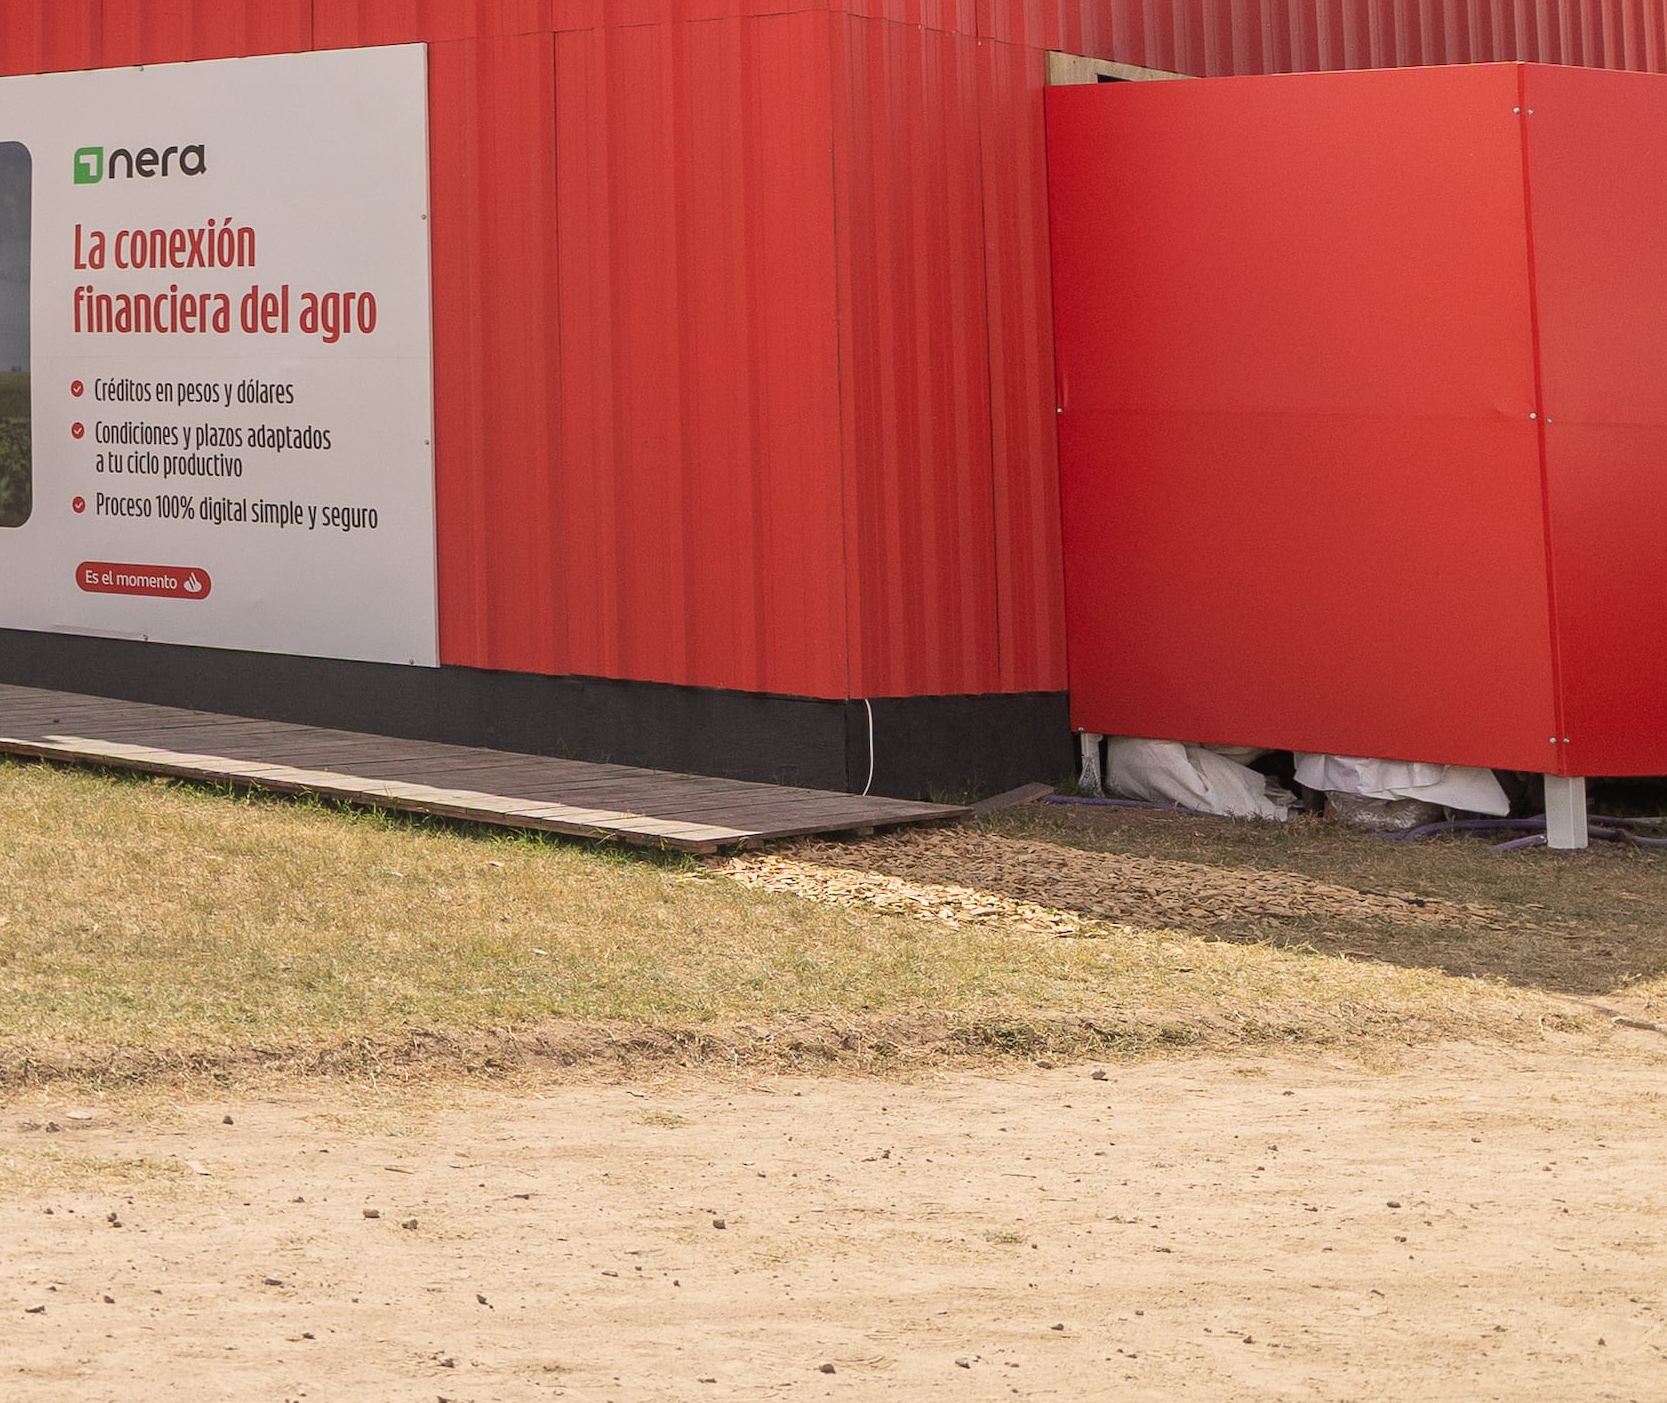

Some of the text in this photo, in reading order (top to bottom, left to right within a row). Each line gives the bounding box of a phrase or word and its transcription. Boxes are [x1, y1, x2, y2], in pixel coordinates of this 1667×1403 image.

[108, 143, 207, 179] nera
[74, 217, 256, 270] La conexión
[74, 284, 377, 344] financiera del agro
[94, 378, 294, 407] Créditos en pesos y dólares
[95, 421, 332, 453] Condiciones y plazos adaptados
[95, 451, 243, 479] a tu ciclo productivo
[96, 492, 379, 533] Proceso 100% digital simple y seguro
[84, 569, 178, 591] Es el momento
